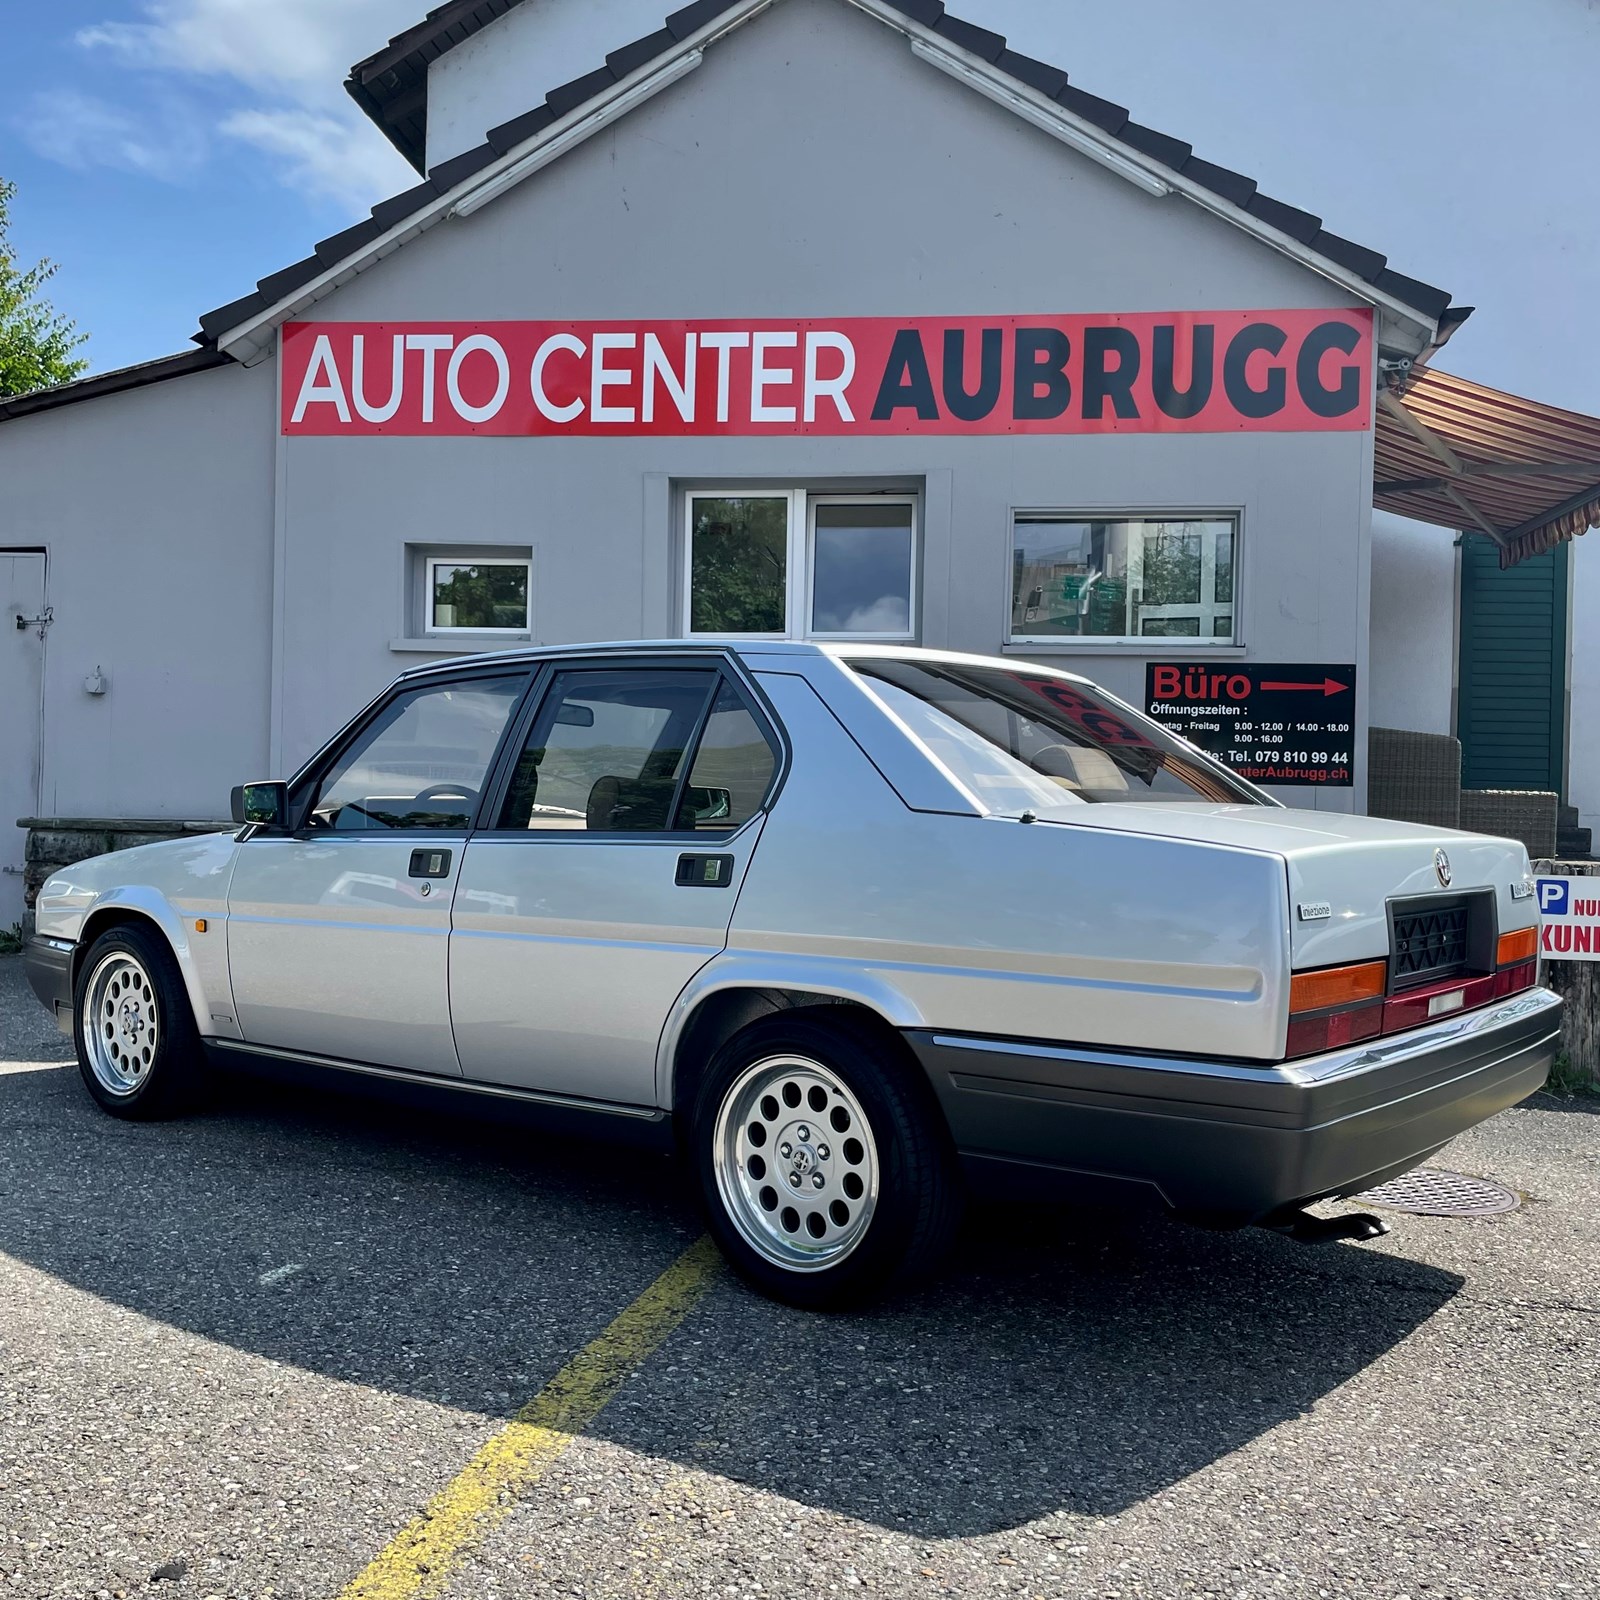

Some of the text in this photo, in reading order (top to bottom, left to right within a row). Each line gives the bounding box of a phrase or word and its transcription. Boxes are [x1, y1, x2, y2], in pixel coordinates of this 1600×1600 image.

[290, 321, 1361, 423] AUTO CENTER AUBRUGG
[1153, 666, 1251, 699] Büro
[1150, 702, 1240, 717] Öffnungszeiten
[1159, 722, 1182, 731] ntag
[1190, 722, 1220, 731] Freitag
[1234, 722, 1252, 731] 9.00
[1260, 723, 1283, 731] 12.00
[1296, 723, 1318, 731] 14.00
[1327, 723, 1349, 732] 18.00
[1234, 734, 1252, 742] 9.00
[1260, 735, 1283, 743] 16.00
[1228, 750, 1251, 762] Tel.
[1255, 751, 1280, 762] 079
[1283, 751, 1307, 763] 810
[1311, 752, 1328, 763] 99
[1331, 752, 1348, 763] 44
[1233, 766, 1348, 780] nterAubrugg.ch
[1541, 883, 1564, 909] P
[1574, 899, 1600, 916] NU
